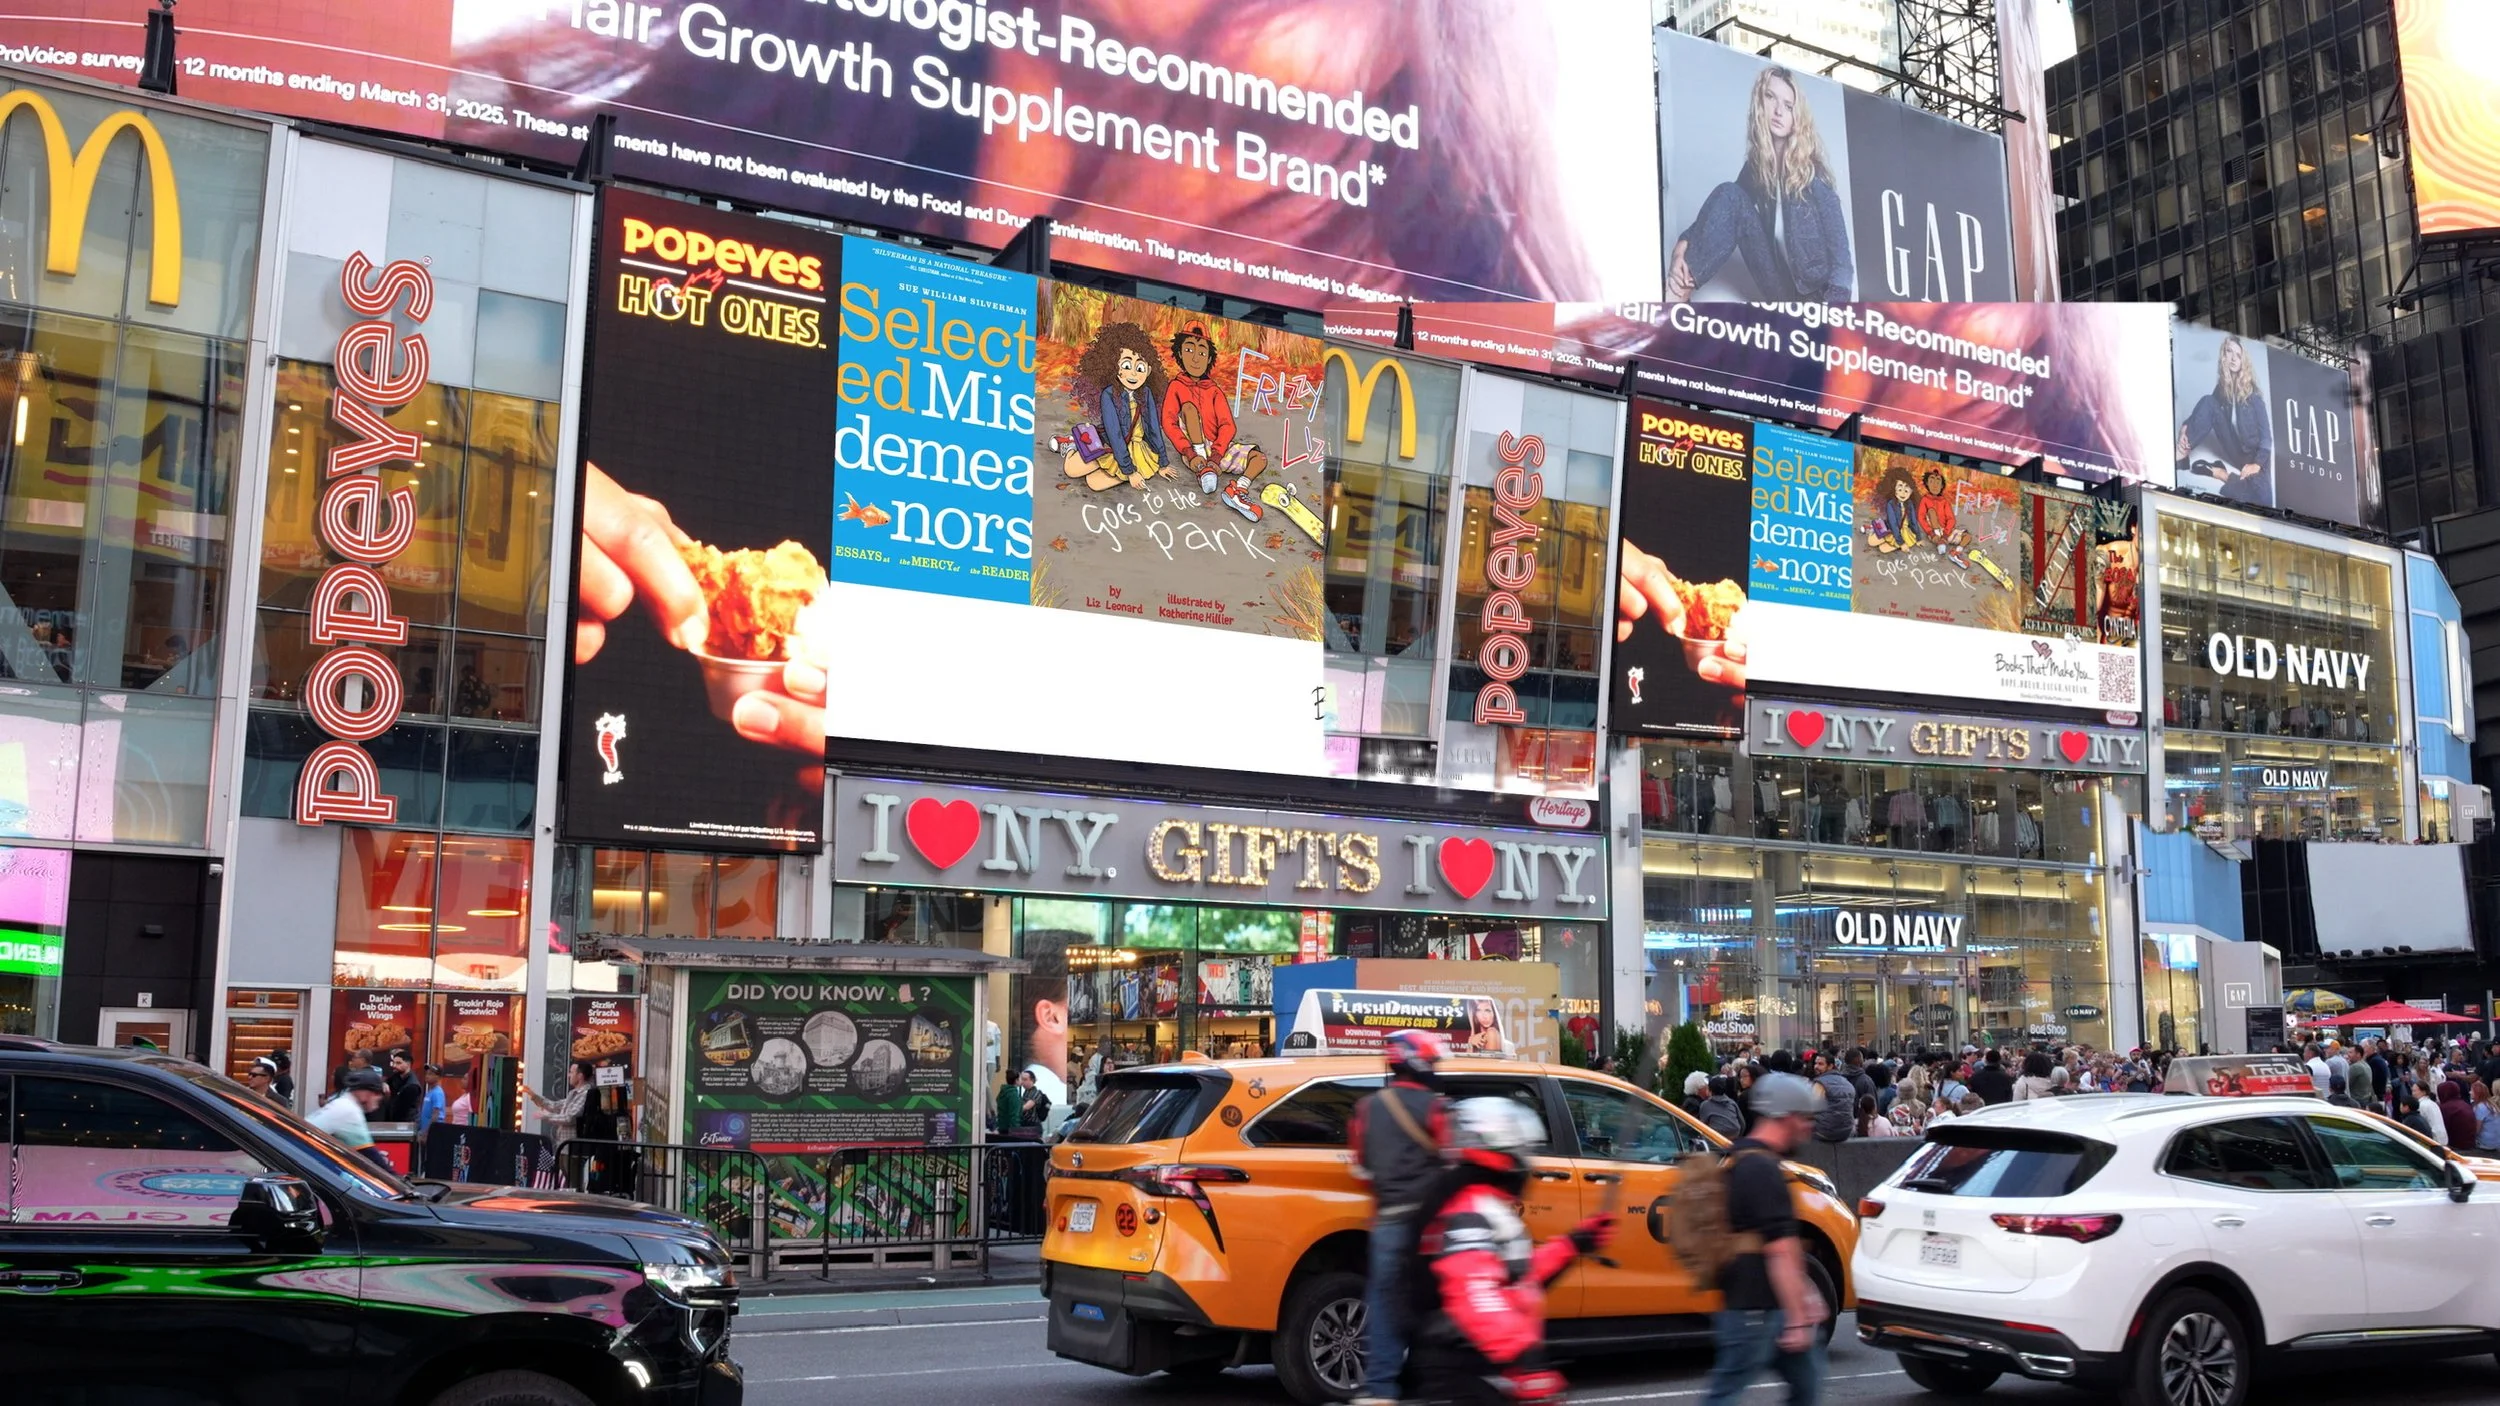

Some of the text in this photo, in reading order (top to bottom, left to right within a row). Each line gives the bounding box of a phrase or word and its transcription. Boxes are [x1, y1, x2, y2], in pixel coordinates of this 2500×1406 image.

[811, 0, 1419, 150] ologist-Recommended
[679, 3, 892, 98] Growth
[911, 55, 1219, 173] Supplement
[0, 44, 77, 65] ProVoice
[81, 52, 145, 75] survey
[184, 59, 205, 77] 12
[209, 62, 284, 88] months
[288, 73, 355, 102] ending
[360, 81, 422, 109] March
[426, 90, 451, 116] 31,
[456, 99, 508, 125] 2025.
[512, 110, 567, 137] These
[571, 124, 668, 158] stments
[671, 140, 712, 166] have
[715, 152, 743, 174] not
[746, 158, 788, 181] been
[791, 168, 867, 198] evaluated
[871, 181, 891, 205] by
[893, 188, 919, 208] the
[921, 193, 962, 217] Food
[964, 203, 993, 223] and
[1049, 222, 1142, 254] dministration.
[1145, 238, 1175, 260] This
[1178, 247, 1231, 276] product
[1234, 258, 1245, 275] is
[1248, 263, 1270, 280] not
[1272, 267, 1328, 293] intended
[1331, 279, 1345, 295] to
[1881, 188, 1985, 302] GAP
[918, 257, 926, 265] IS
[934, 261, 970, 274] NATIONAL
[618, 273, 712, 326] HOT
[899, 282, 1028, 315] SUE WILLIAM SILVERMAN
[839, 282, 1036, 374] Select
[1671, 303, 1780, 352] Growth
[1789, 330, 1947, 390] Supplement
[1234, 347, 1324, 422] FRIZZY
[837, 356, 1035, 435] ed Mis
[2285, 398, 2340, 464] GAP
[834, 414, 1034, 498] demea
[1752, 446, 1853, 493] Select
[2290, 460, 2342, 481] STUDIO
[1794, 487, 1853, 525] Mis
[890, 499, 1033, 560] nors
[1082, 487, 1201, 553] Goes to the
[1750, 514, 1852, 557] demea
[835, 545, 882, 562] ESSAYS
[911, 556, 954, 571] MERCY
[982, 566, 1029, 581] READER
[1922, 552, 1938, 563] the
[1779, 557, 1852, 589] nors
[1109, 585, 1121, 598] by
[1086, 596, 1143, 614] Liz Leonard
[1167, 594, 1225, 612] illustrated by
[1159, 607, 1234, 626] Katherine Hillier
[1994, 653, 2025, 675] Books
[2208, 632, 2370, 691] OLD NAVY
[1764, 708, 1784, 744] I
[1909, 720, 2030, 760] GIFTS
[2042, 729, 2058, 760] I
[2262, 769, 2328, 788] OLD NAVY
[1535, 799, 1587, 823] Heritage
[861, 792, 900, 863] I
[1145, 817, 1381, 894] GIFTS
[1404, 834, 1436, 895] I
[1835, 910, 1962, 948] OLD NAVY
[727, 984, 765, 1000] DID
[771, 985, 813, 1000] YOU
[819, 985, 885, 1001] KNOW
[2230, 987, 2246, 1001] GAP
[360, 1002, 402, 1012] Dab Ghost
[453, 999, 504, 1009] Smokin' Rojo
[459, 1008, 498, 1016] Sandwich
[588, 1009, 620, 1017] Sriracha
[1332, 998, 1464, 1018] FLASHDANCERS
[1722, 1008, 1740, 1020] The
[2079, 1008, 2097, 1016] NAVY
[367, 1011, 393, 1020] Wings
[588, 1017, 619, 1026] Dippers
[1363, 1015, 1438, 1028] GENTLEMEN'S CLUBS
[2040, 1012, 2056, 1023] The
[1345, 1028, 1381, 1037] DOWNTOWN
[1707, 1021, 1755, 1034] Bag Shop
[2030, 1023, 2067, 1036] Bag Shop
[2245, 1063, 2303, 1075] TRON
[1119, 1208, 1135, 1230] 22
[1628, 1206, 1646, 1214] NYC
